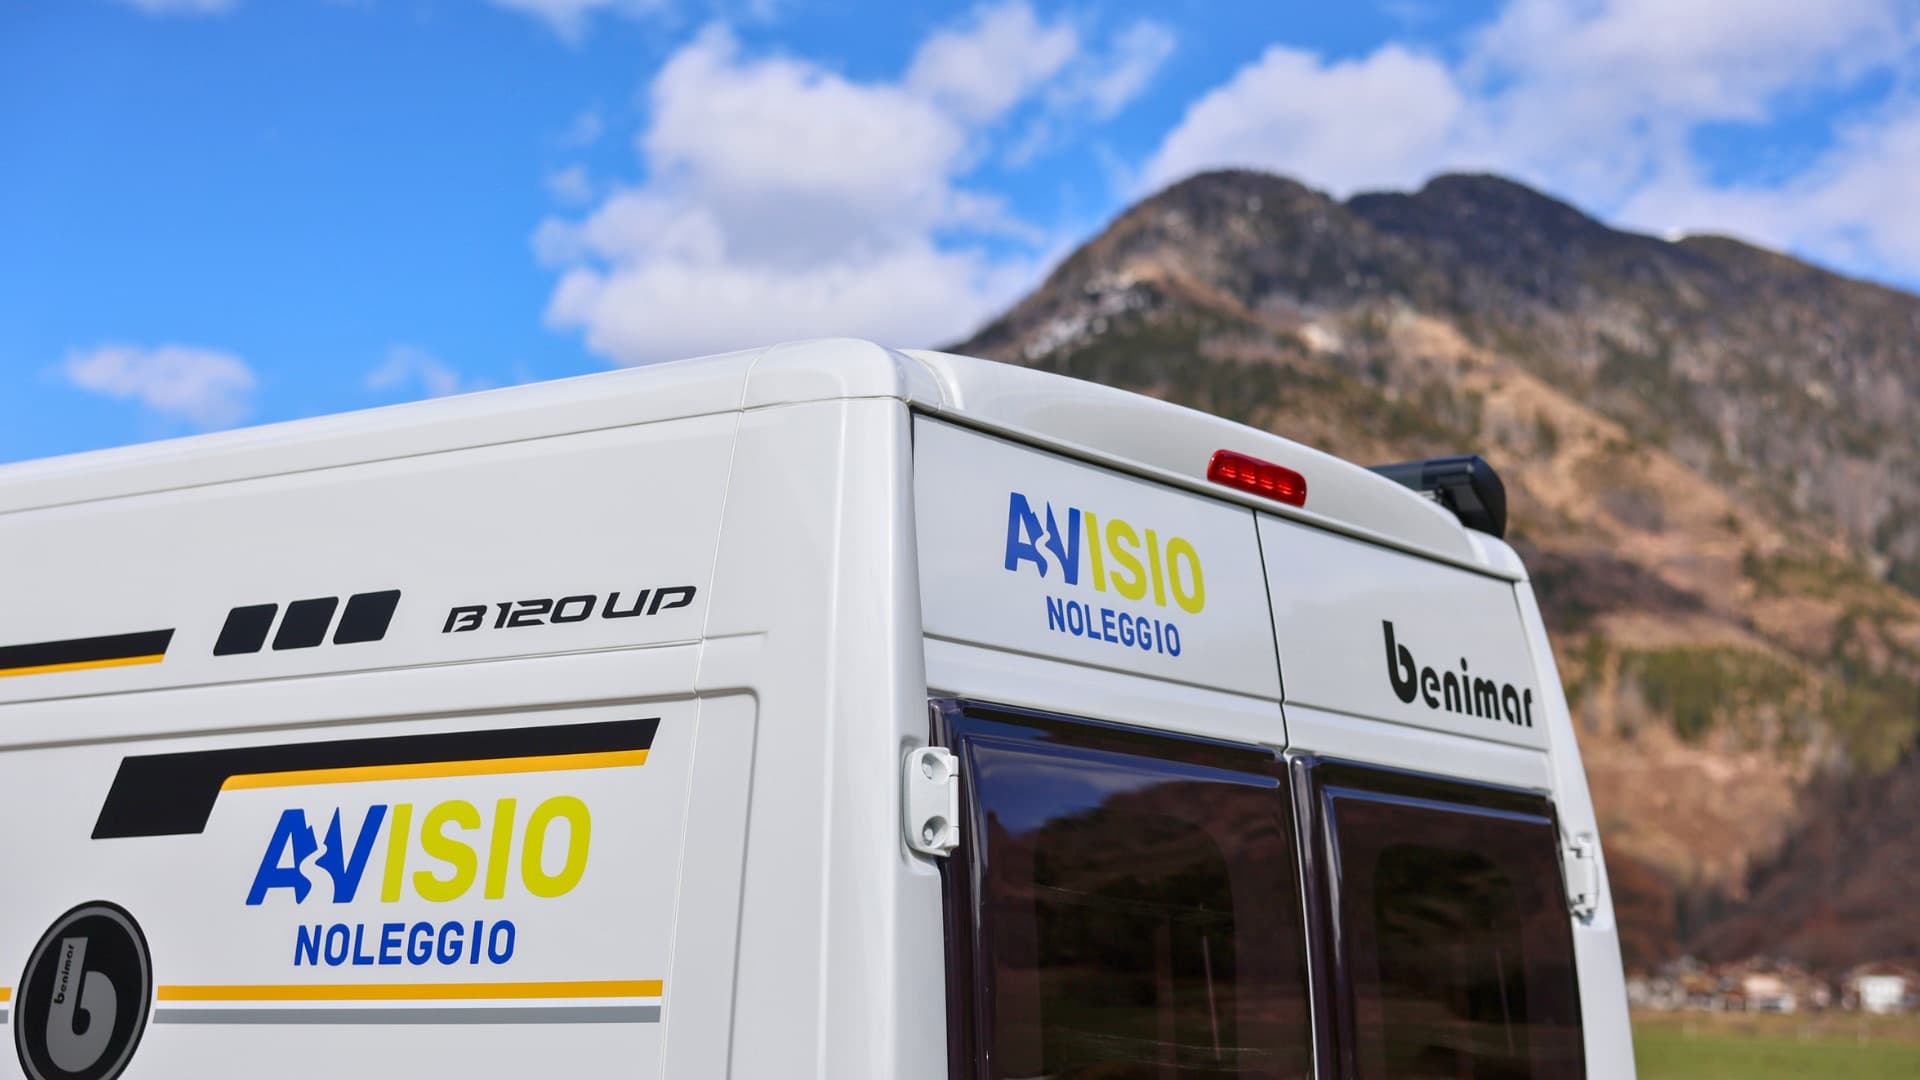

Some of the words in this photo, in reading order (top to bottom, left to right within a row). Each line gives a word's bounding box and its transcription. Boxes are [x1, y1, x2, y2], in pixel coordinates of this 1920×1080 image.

[1004, 492, 1206, 614] AVISIO
[601, 585, 697, 619] UP
[1046, 596, 1181, 657] NOLEGGIO
[1382, 620, 1533, 728] benimar
[245, 796, 592, 905] AVISIO
[294, 919, 516, 966] NOLEGGIO
[54, 944, 75, 1005] benimar
